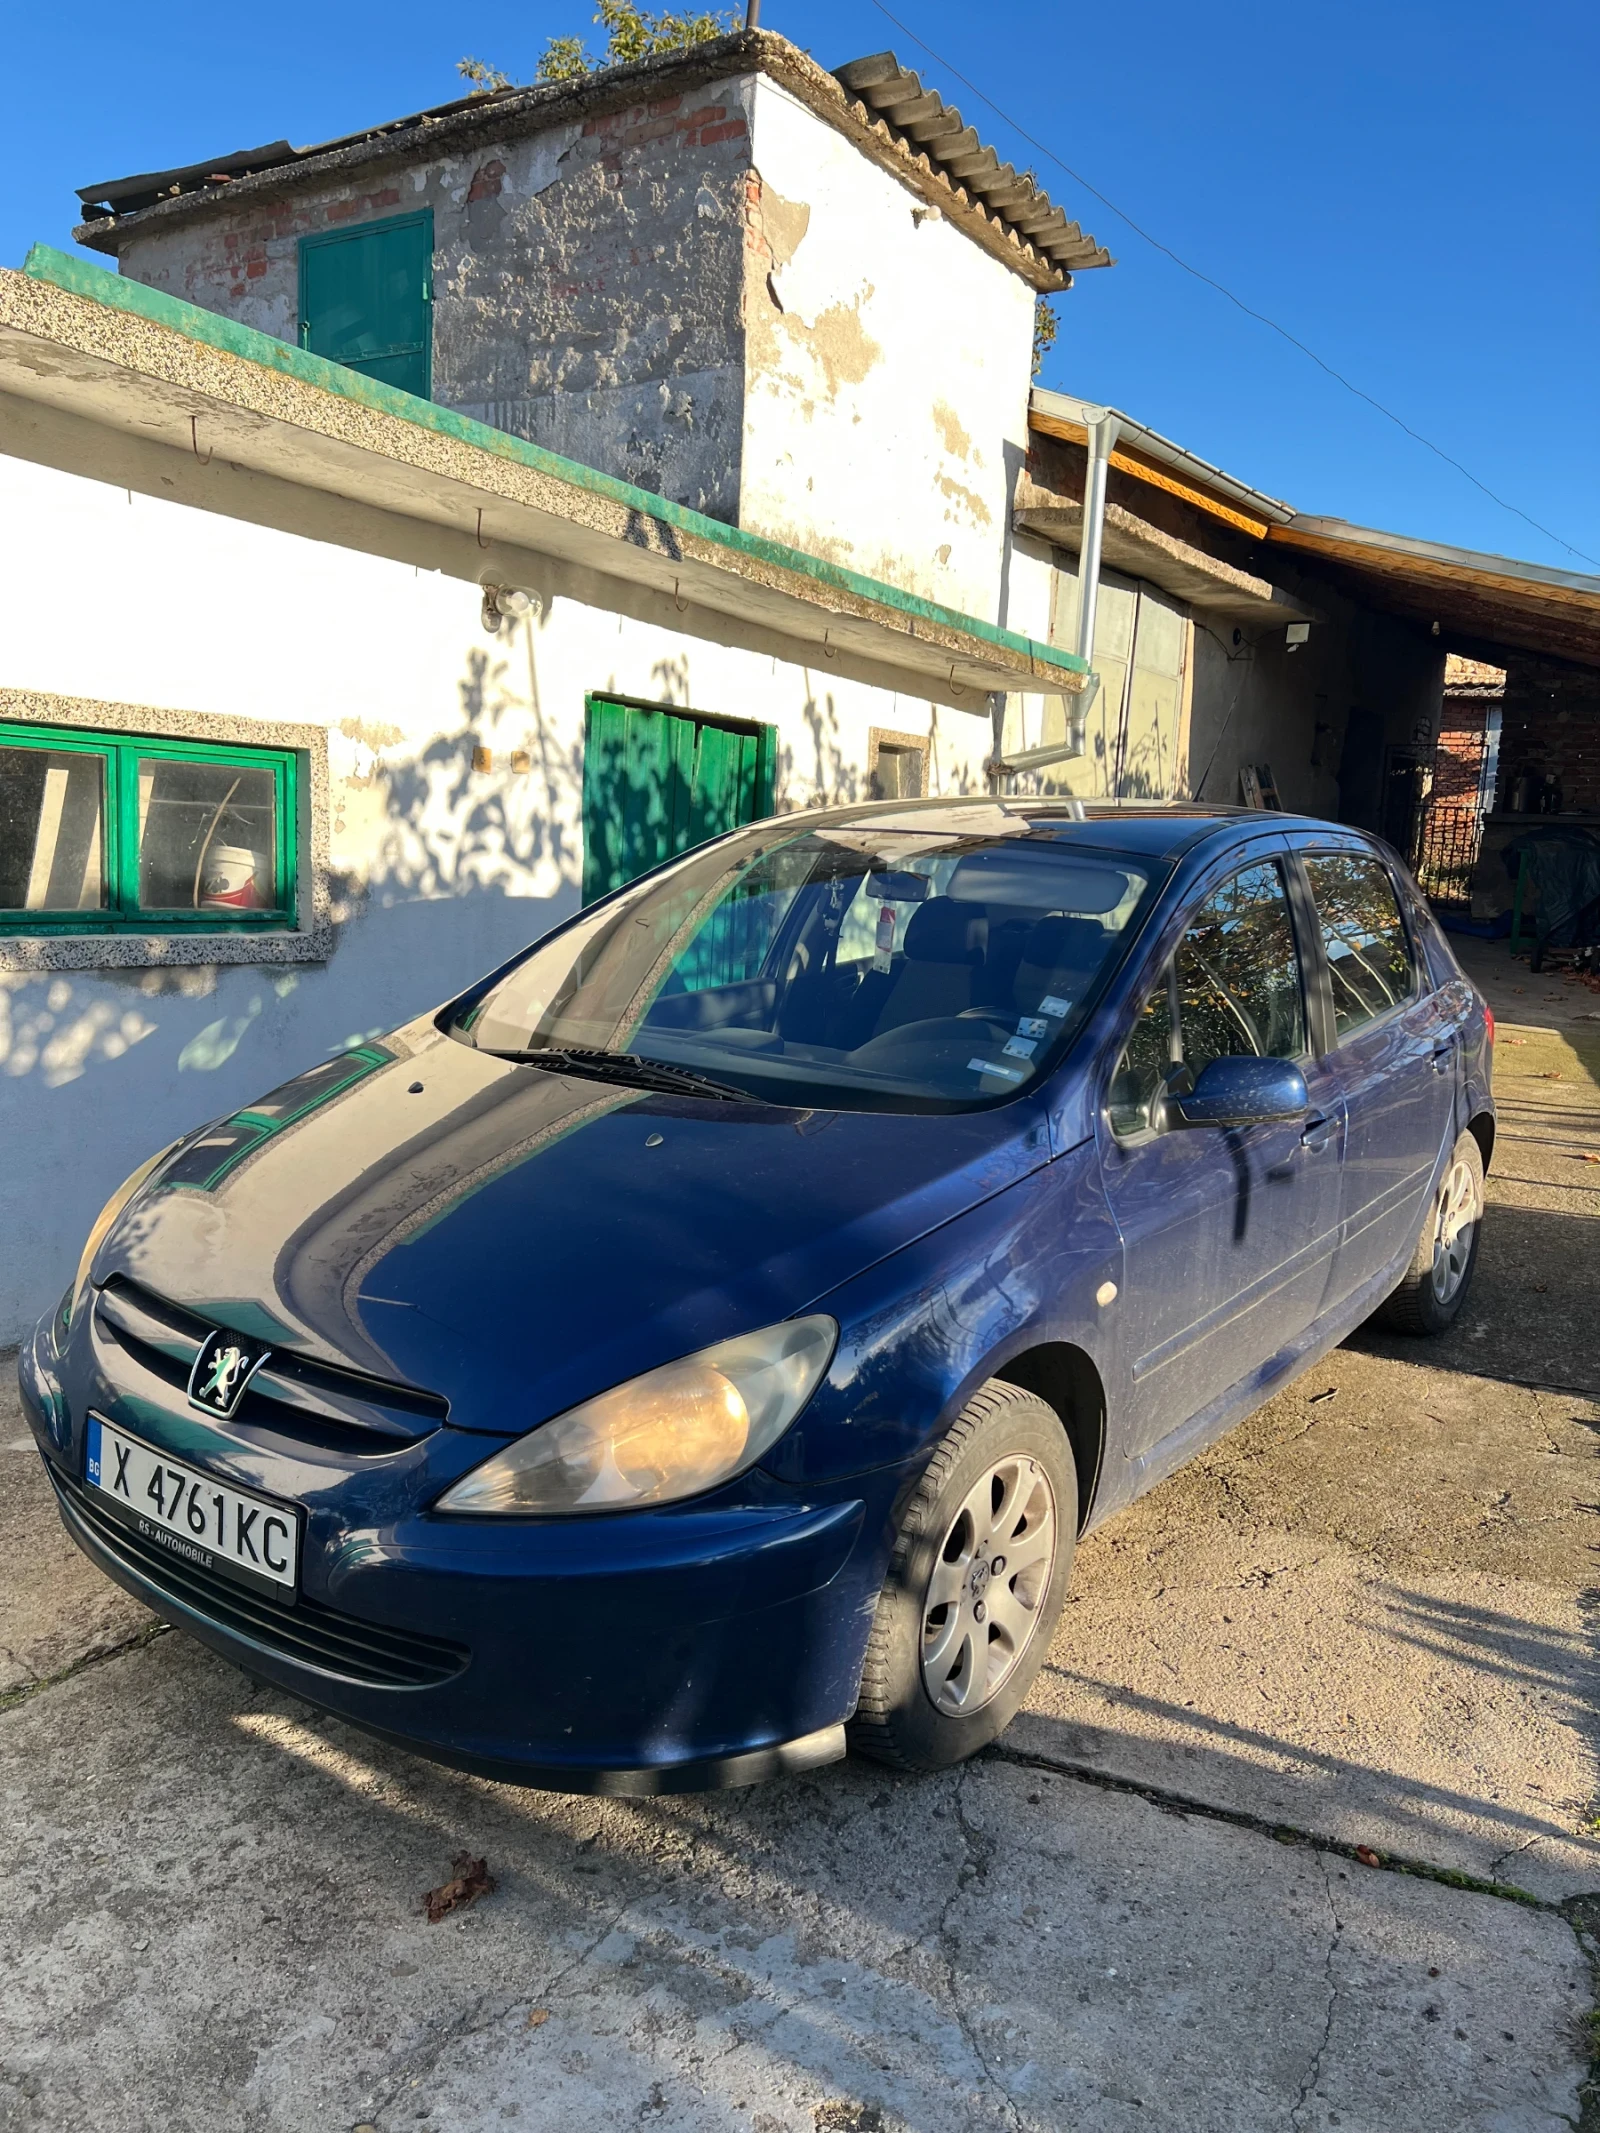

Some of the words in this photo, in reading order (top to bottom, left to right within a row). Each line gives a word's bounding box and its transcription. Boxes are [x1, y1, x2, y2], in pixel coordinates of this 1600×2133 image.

[89, 1457, 100, 1476] BG
[114, 1440, 131, 1497] X
[155, 1531, 213, 1568] AUTOMOBILE
